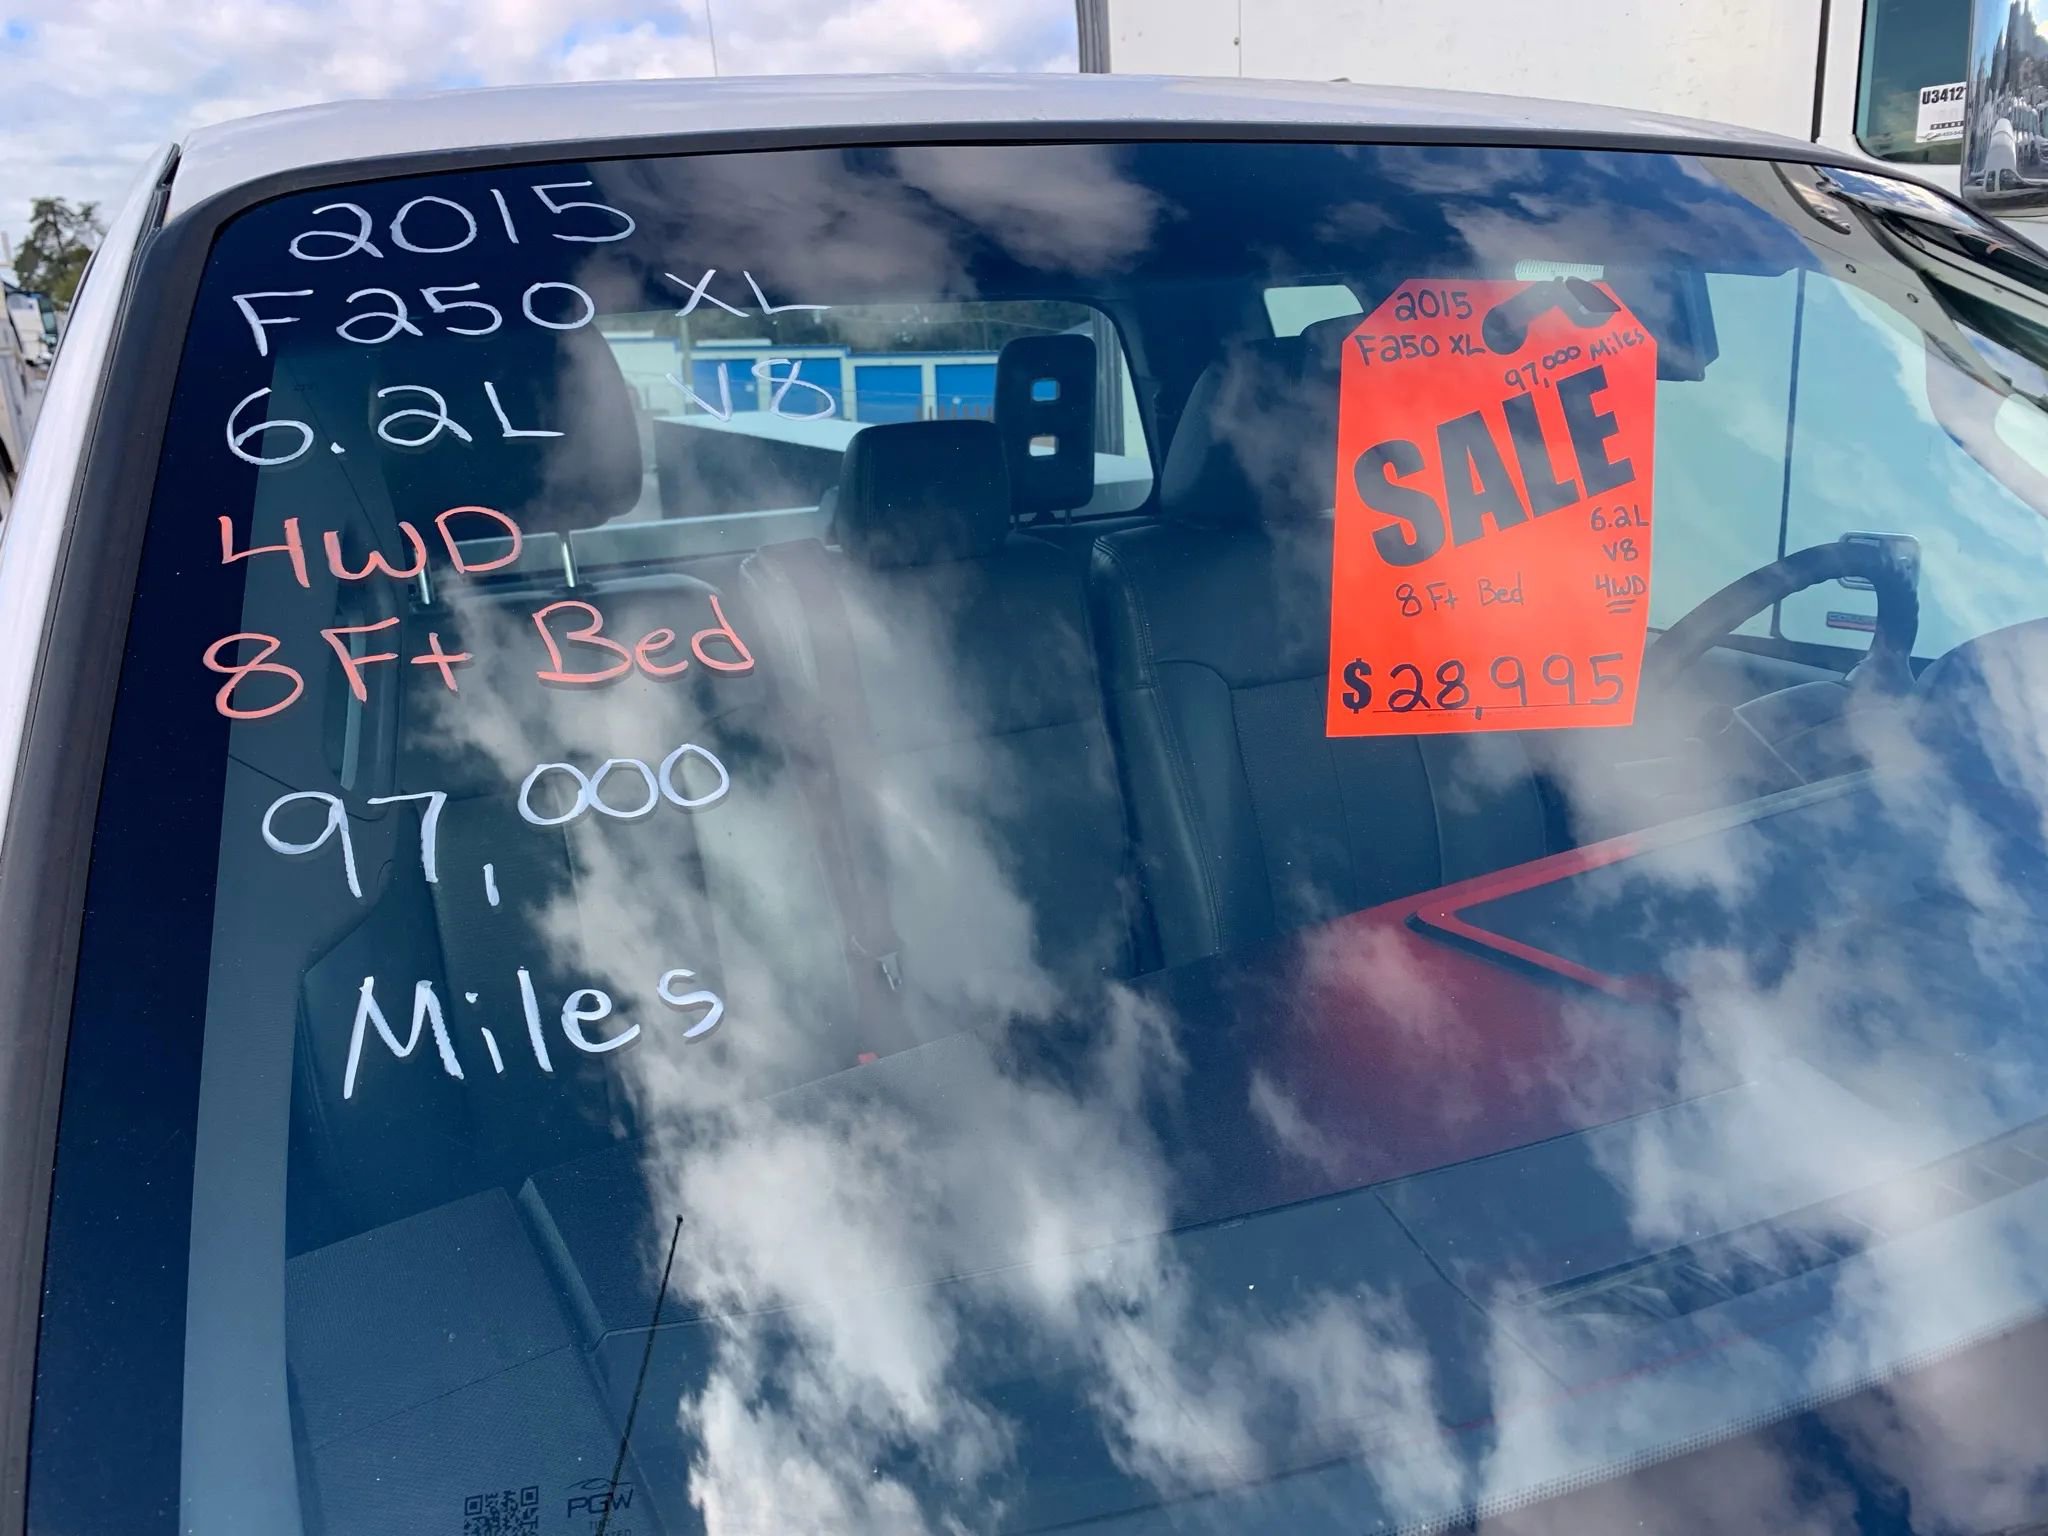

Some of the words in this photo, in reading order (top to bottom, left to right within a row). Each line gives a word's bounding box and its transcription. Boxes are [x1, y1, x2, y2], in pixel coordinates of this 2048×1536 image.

[1922, 86, 1967, 105] U3412
[289, 180, 636, 261] 2015
[231, 281, 596, 357] F250
[664, 268, 832, 318] XL
[1394, 288, 1474, 322] 2015
[1354, 333, 1440, 367] F250
[1449, 334, 1488, 356] XL
[1503, 344, 1582, 392] 97,000
[1587, 326, 1646, 362] Miles
[225, 381, 565, 466] 6.2L
[664, 357, 837, 422] V8
[1353, 364, 1637, 568] SALE
[217, 505, 524, 589] 4WD
[1589, 504, 1650, 532] 6.2L
[1602, 537, 1640, 562] V8
[1395, 583, 1423, 618] 8
[1477, 572, 1526, 606] Bed
[1594, 573, 1647, 599] 4WD
[531, 594, 755, 685] Bed
[1341, 652, 1625, 721] $28,995
[261, 743, 730, 907] 97,000
[343, 966, 724, 1100] Miles
[567, 1488, 634, 1518] PGW
